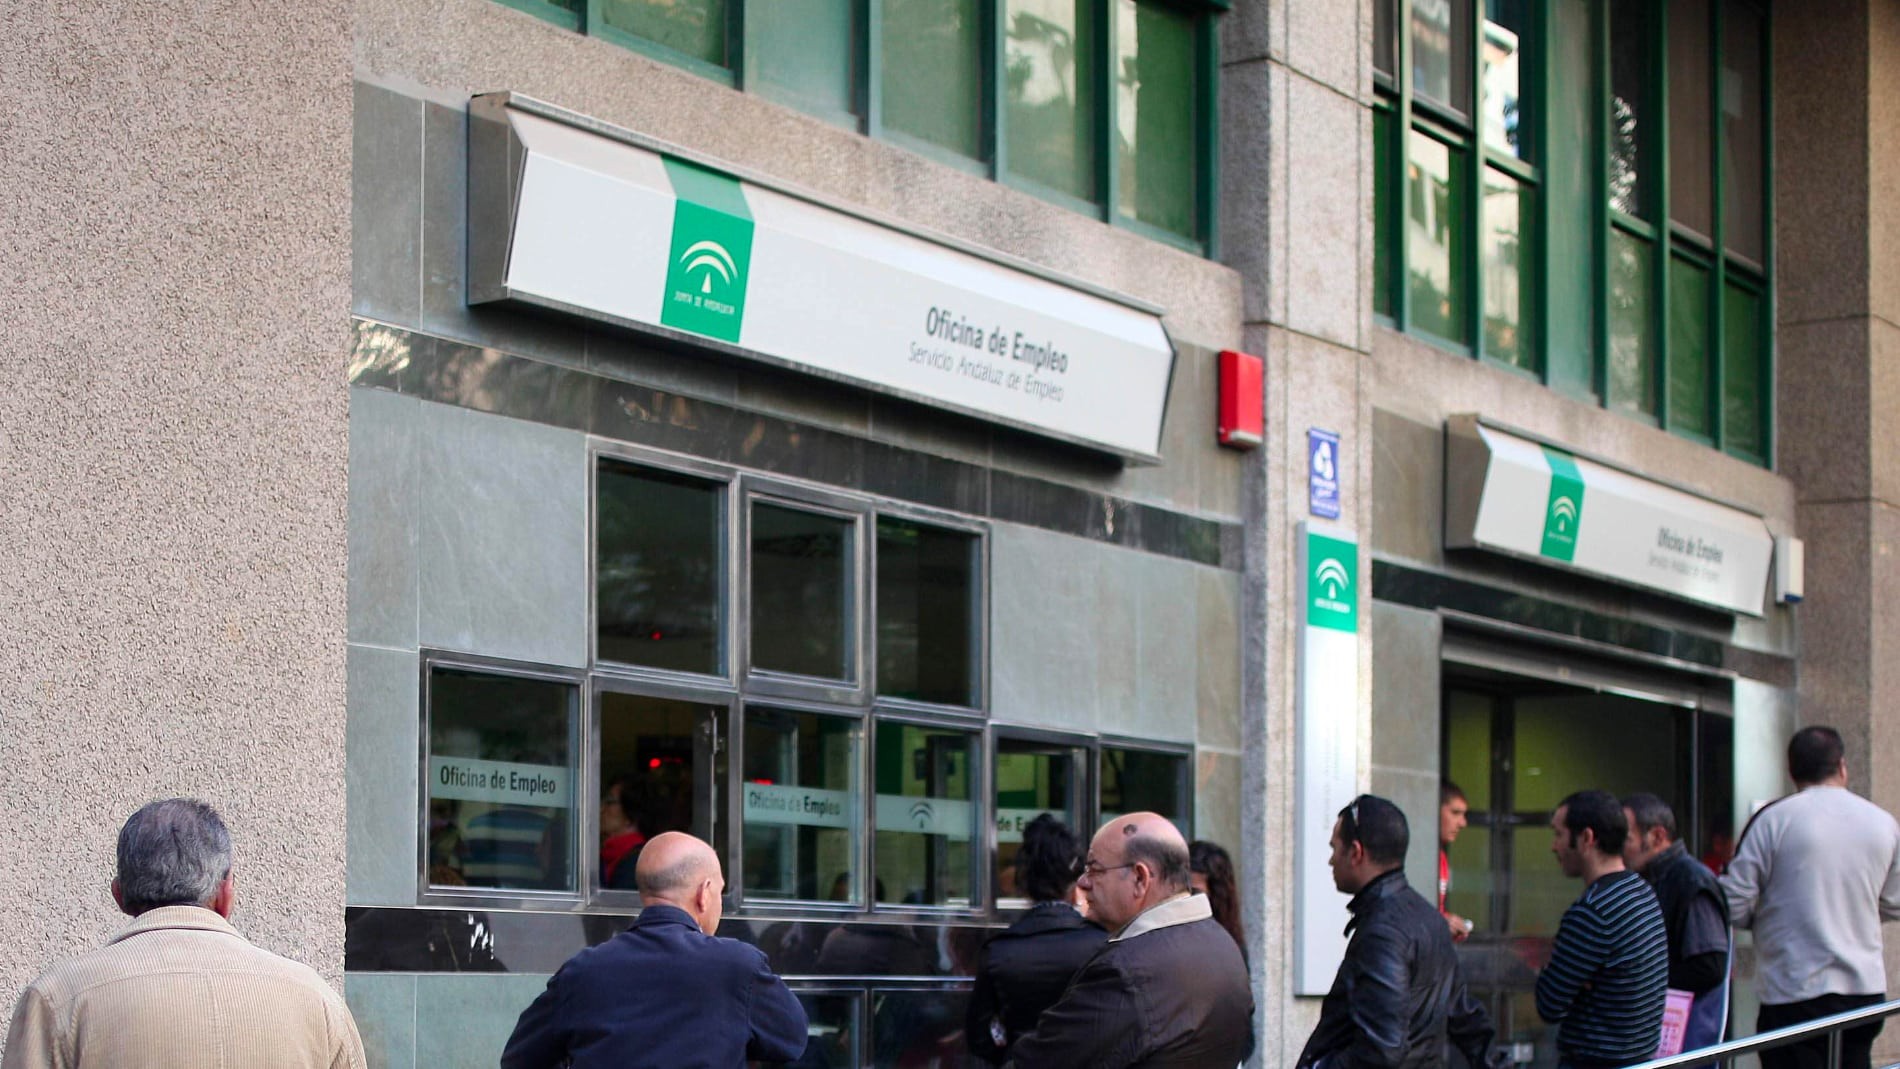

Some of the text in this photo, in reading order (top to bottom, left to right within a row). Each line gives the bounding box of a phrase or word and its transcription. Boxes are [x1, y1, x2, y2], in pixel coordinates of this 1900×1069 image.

[926, 306, 1068, 374] Oficina de Empleo
[908, 341, 1065, 402] Servicio Andaluz de Empleo
[440, 765, 556, 796] Oficina de Empleo
[749, 790, 841, 818] Oficina de Empleo
